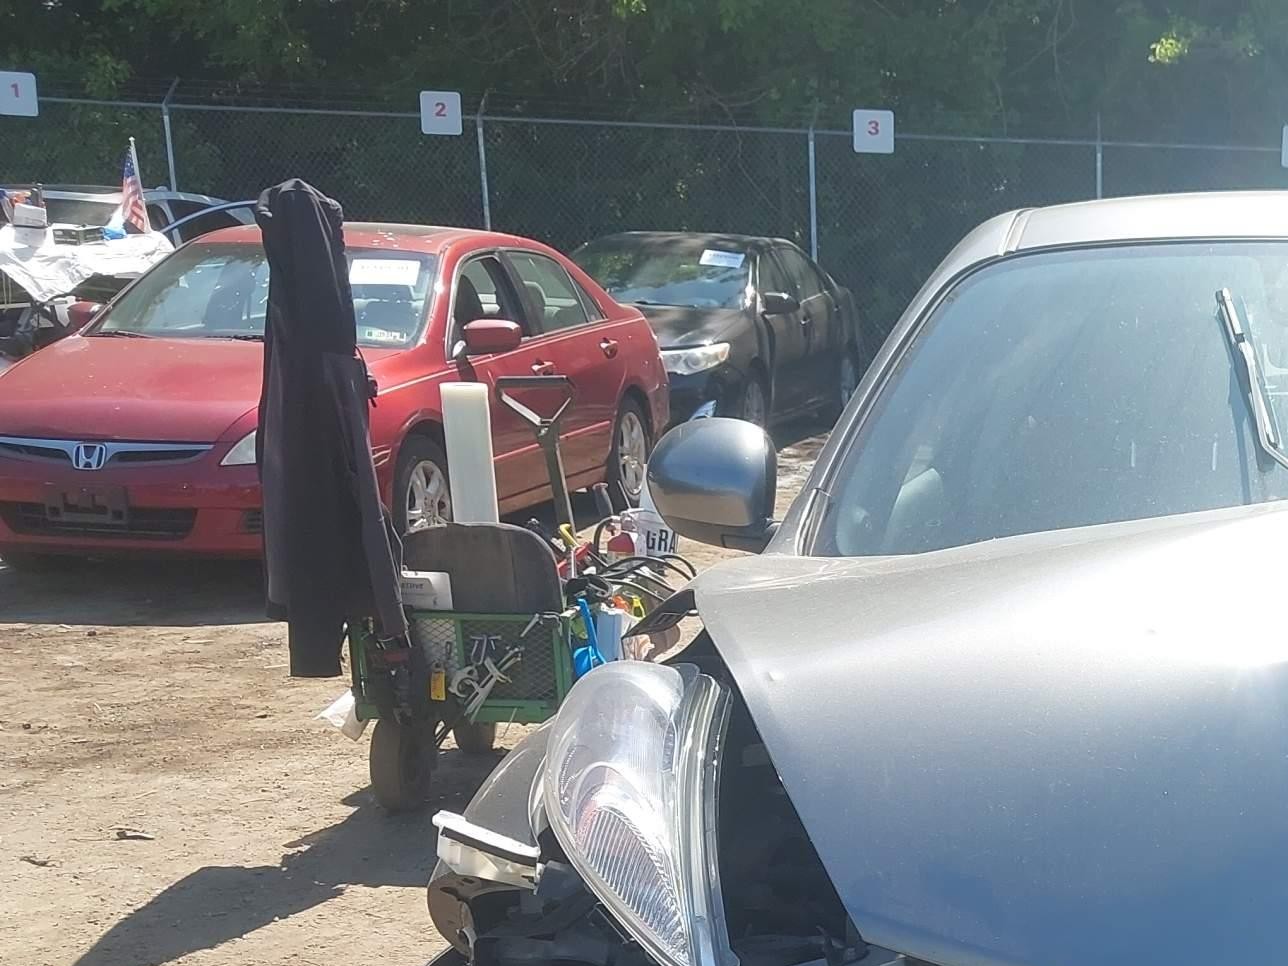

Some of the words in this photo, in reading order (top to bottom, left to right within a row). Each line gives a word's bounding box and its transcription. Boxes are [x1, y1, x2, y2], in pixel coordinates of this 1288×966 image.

[10, 83, 20, 98] 1
[434, 102, 447, 117] 2
[867, 120, 880, 135] 3
